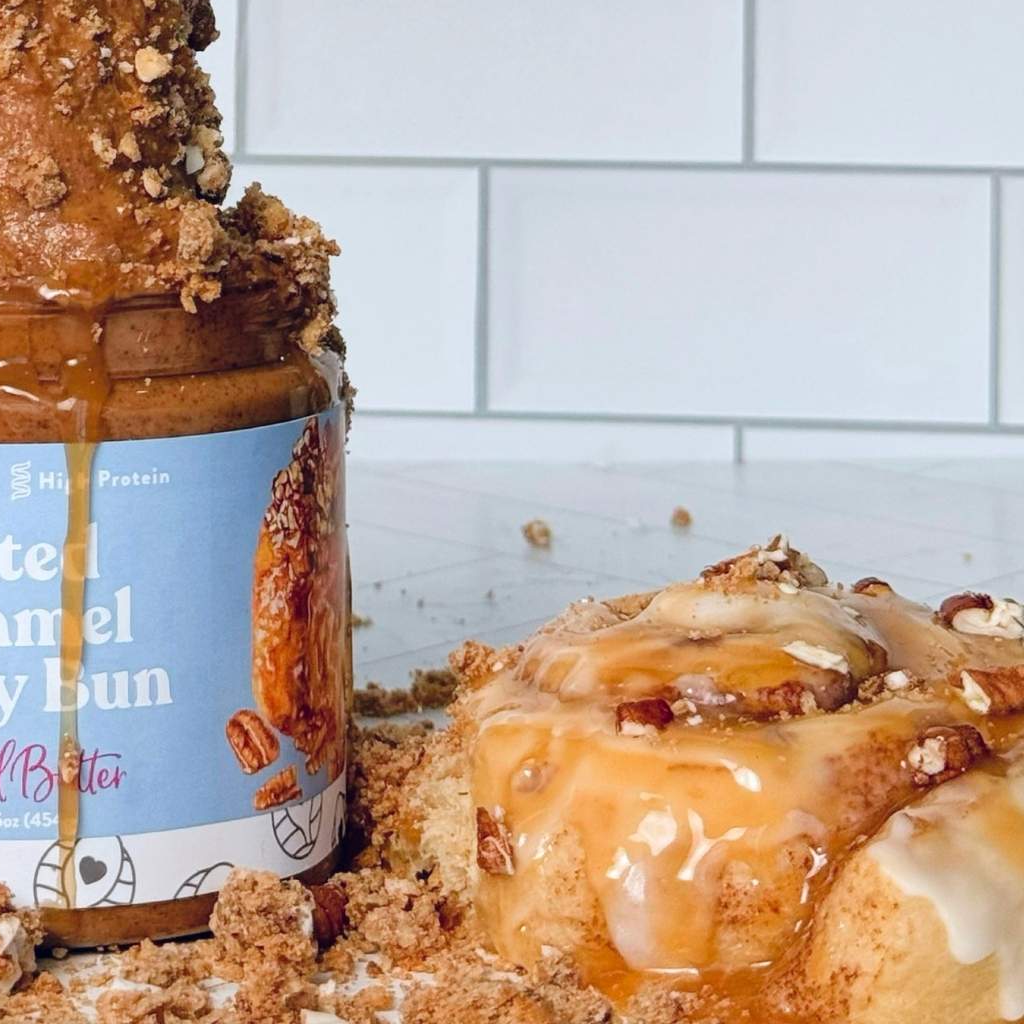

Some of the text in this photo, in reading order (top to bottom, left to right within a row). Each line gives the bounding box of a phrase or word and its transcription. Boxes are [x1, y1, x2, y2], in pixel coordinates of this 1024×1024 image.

[39, 468, 170, 495] Hi Protein
[43, 657, 174, 711] Bun
[10, 744, 127, 802] Btter
